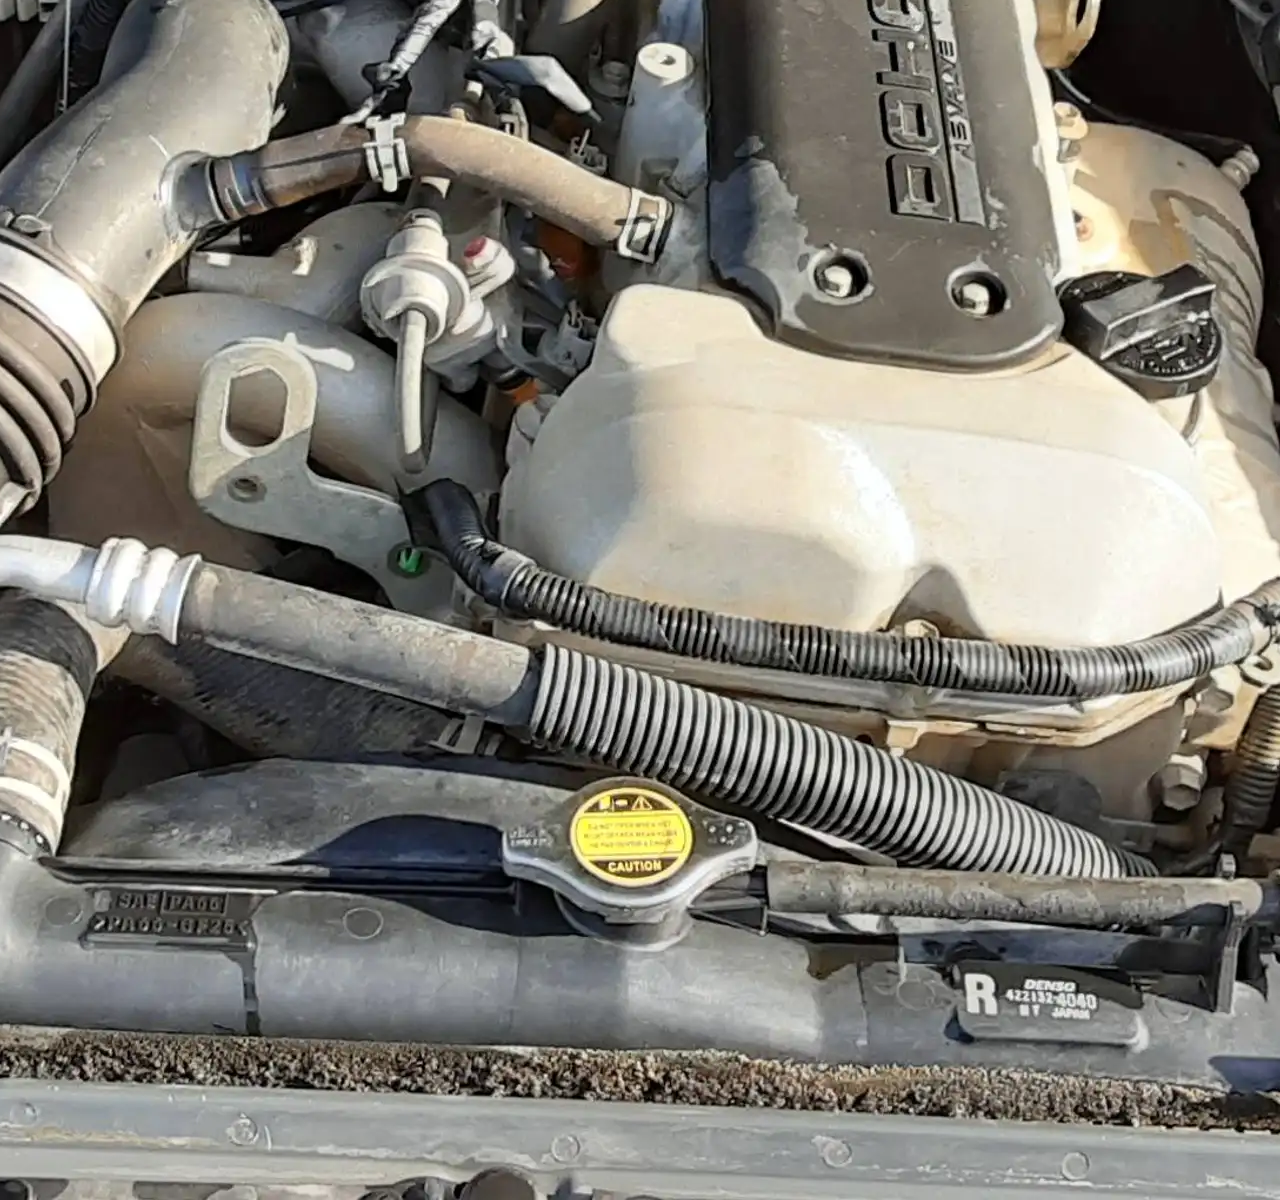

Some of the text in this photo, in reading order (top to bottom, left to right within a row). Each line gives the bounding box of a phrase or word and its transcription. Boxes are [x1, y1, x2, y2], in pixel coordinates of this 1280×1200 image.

[608, 861, 662, 873] CAUTION
[1023, 979, 1077, 993] DENSO
[964, 973, 998, 1015] R
